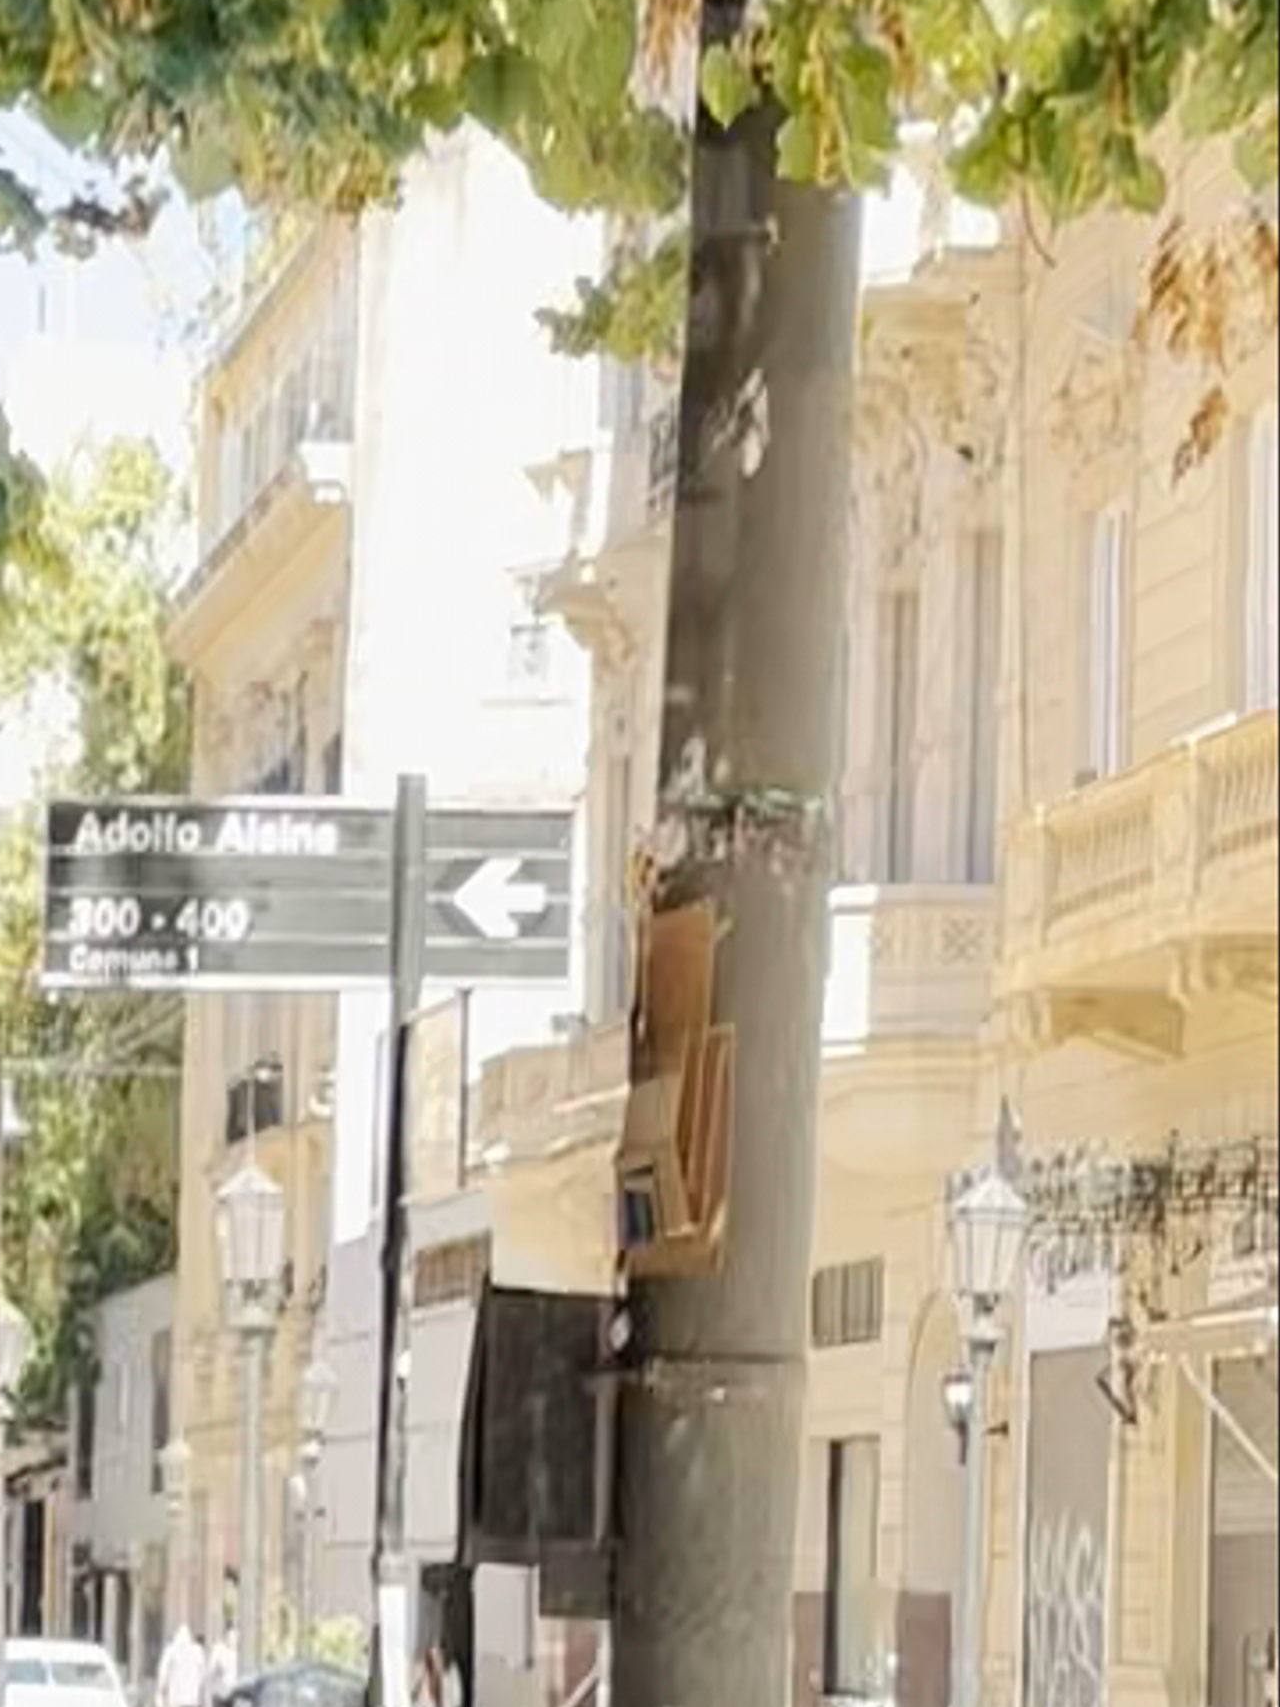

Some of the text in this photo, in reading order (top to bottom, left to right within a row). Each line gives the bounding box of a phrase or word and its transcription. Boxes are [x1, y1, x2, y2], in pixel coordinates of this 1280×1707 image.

[72, 810, 339, 855] Adolfo Alsina
[68, 897, 141, 939] 300
[175, 897, 251, 941] 400
[185, 944, 200, 972] 1
